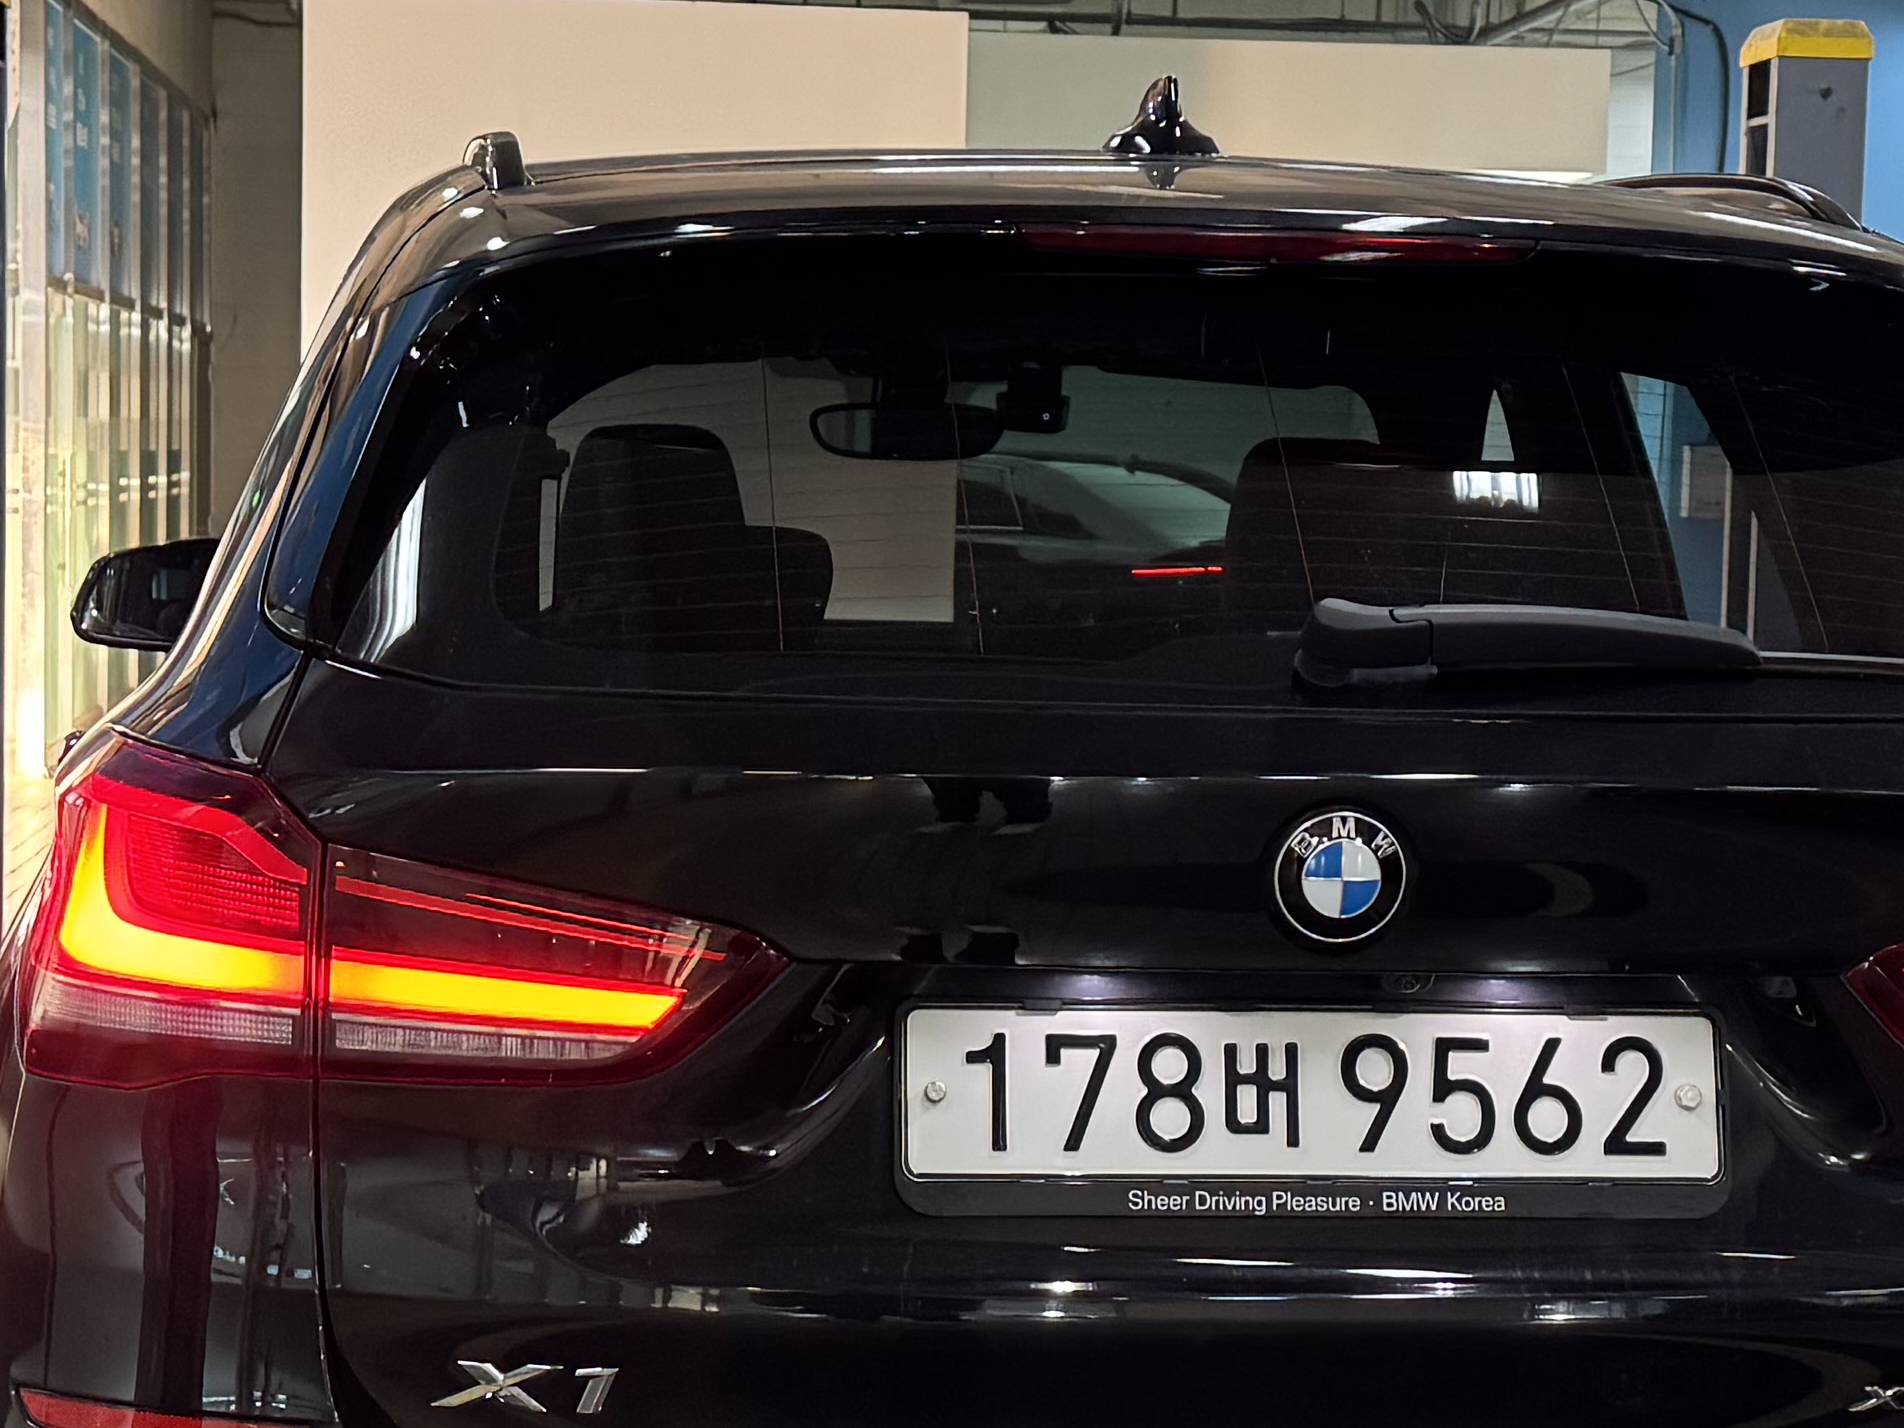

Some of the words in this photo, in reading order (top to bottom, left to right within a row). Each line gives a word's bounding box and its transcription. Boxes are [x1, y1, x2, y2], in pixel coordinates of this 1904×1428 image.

[1291, 816, 1397, 859] BMW
[965, 1032, 1300, 1153] 178버
[1340, 1035, 1668, 1157] 9562
[1127, 1189, 1189, 1211] Sheer
[1196, 1190, 1267, 1215] Driving
[1272, 1190, 1361, 1212] Pleasure
[1382, 1191, 1440, 1212] BMW
[1448, 1191, 1506, 1212] Korea
[430, 1360, 620, 1414] X1
